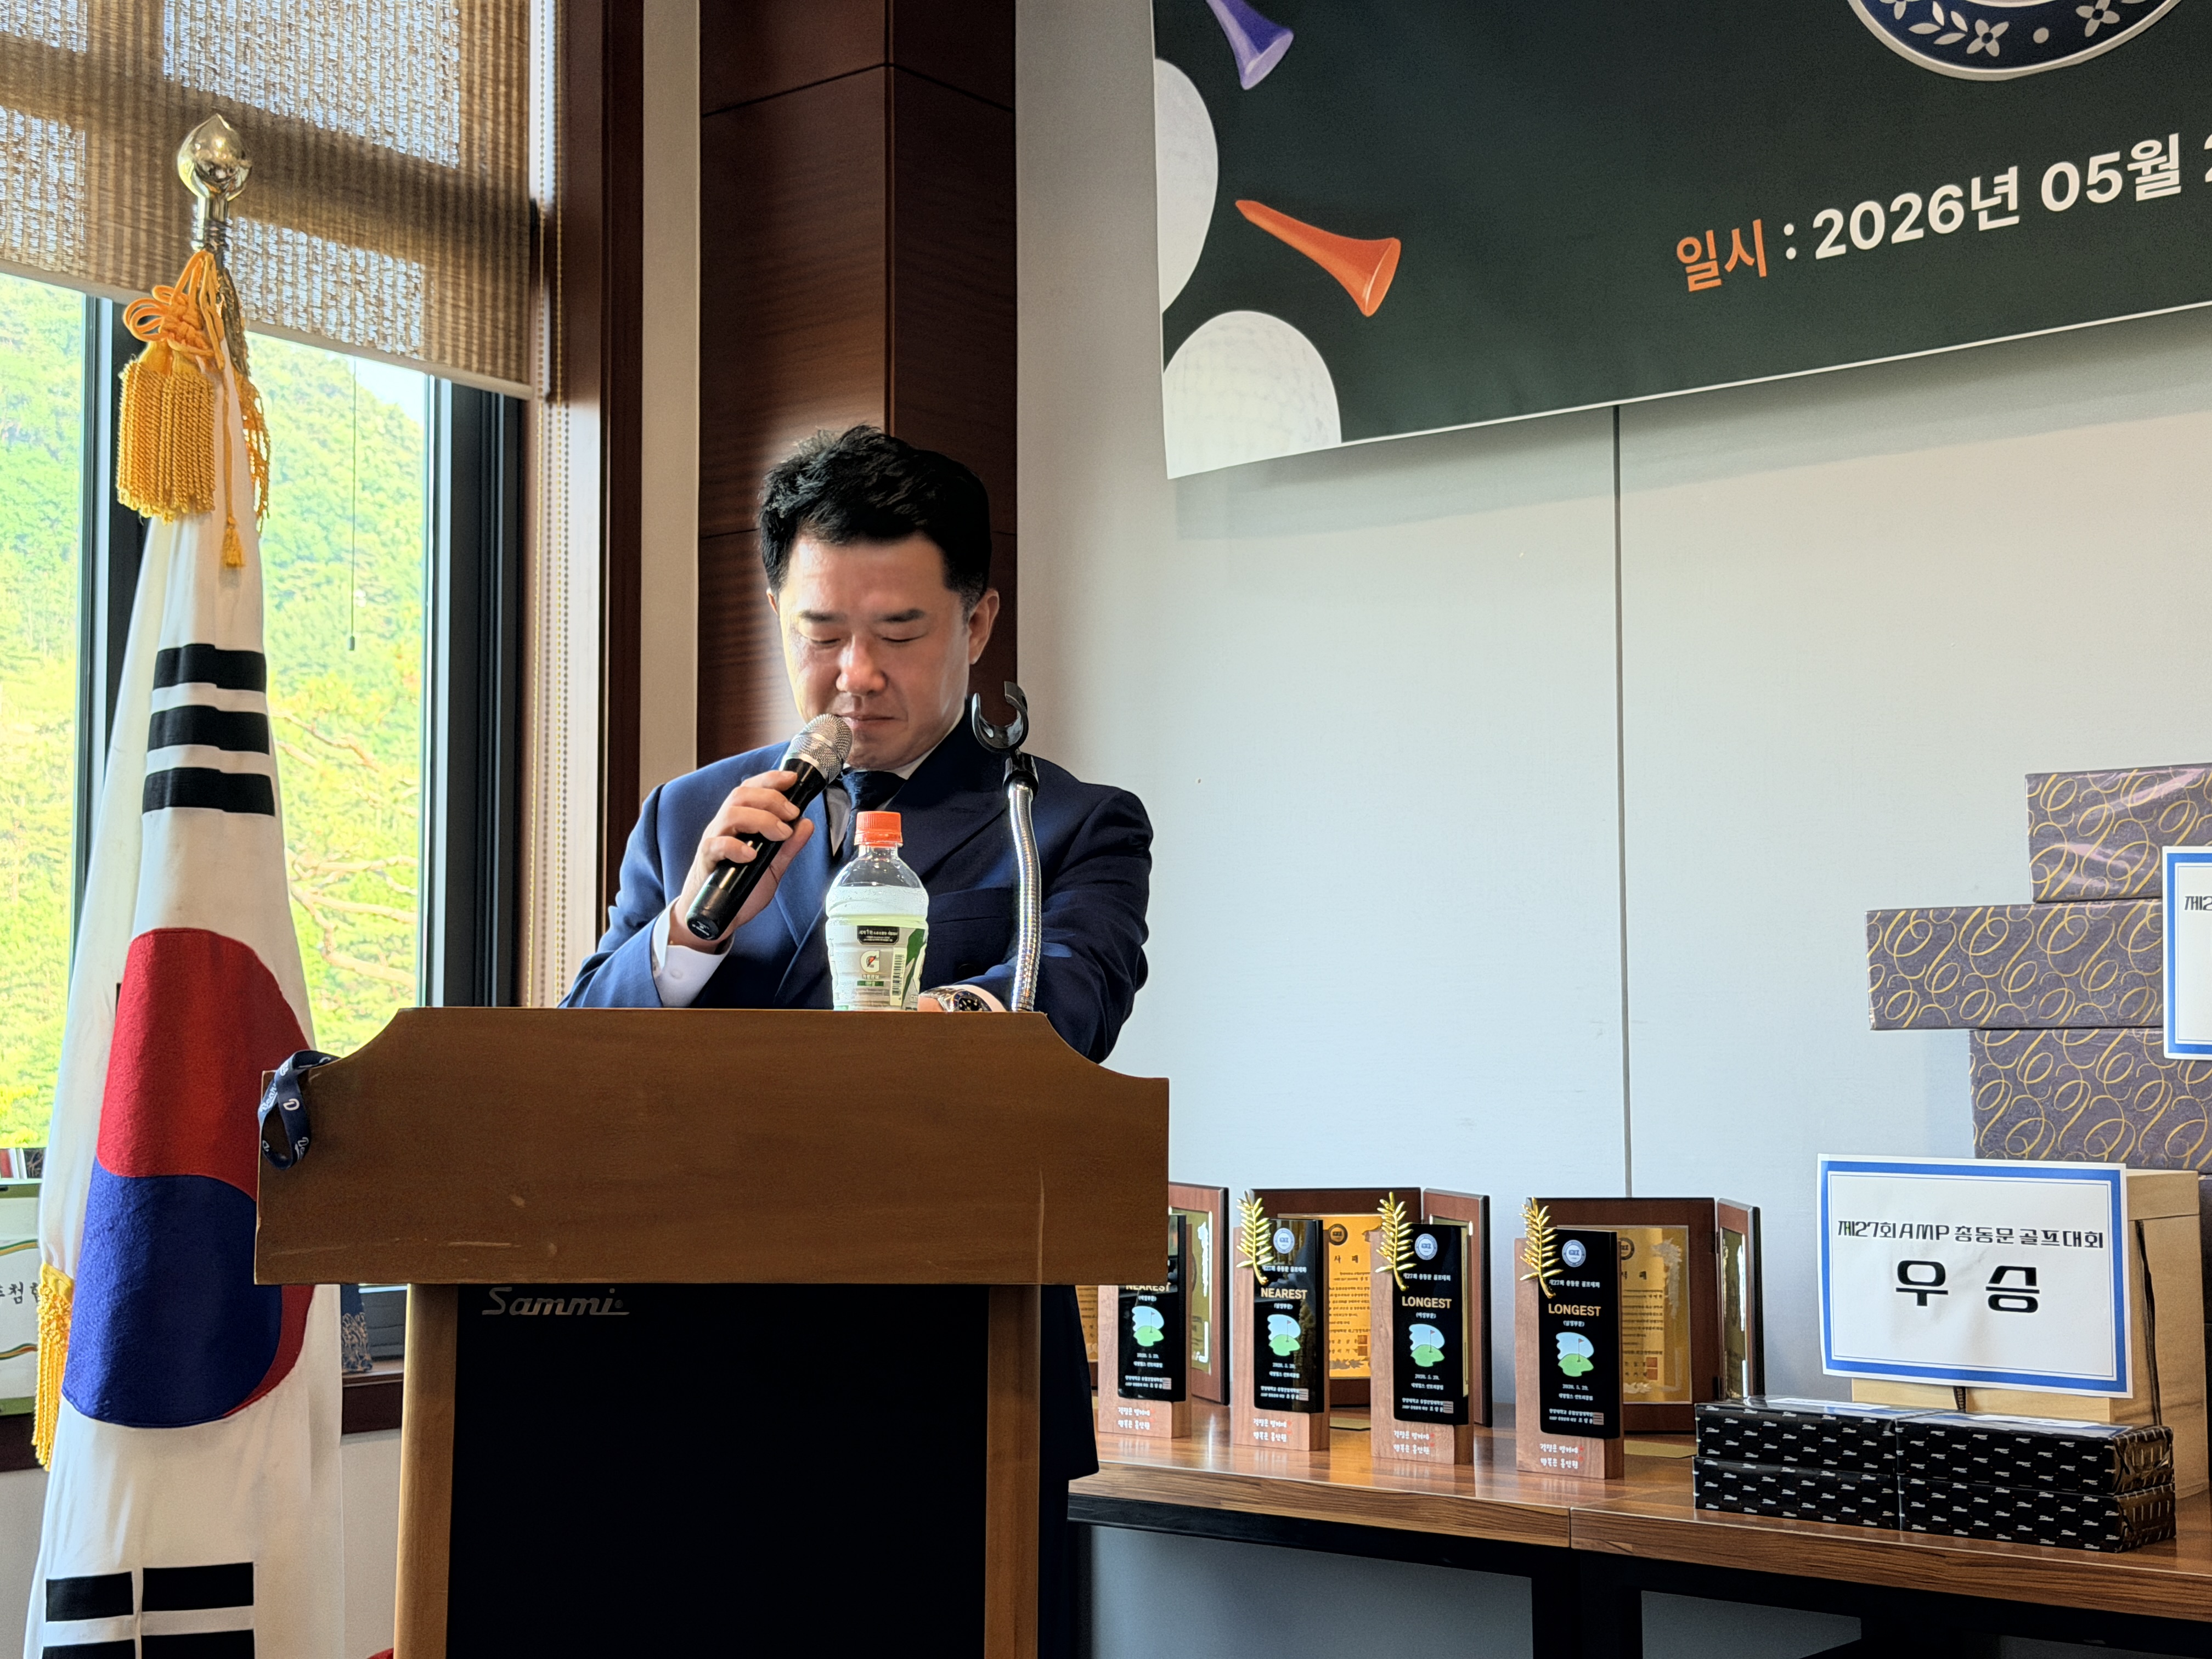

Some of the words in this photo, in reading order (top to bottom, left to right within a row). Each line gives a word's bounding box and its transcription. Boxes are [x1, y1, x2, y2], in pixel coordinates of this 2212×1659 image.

[1677, 219, 1767, 292] 일시
[1813, 166, 2020, 260] 2026년
[2041, 133, 2181, 212] 05월
[1838, 1221, 1897, 1239] 제27회
[1899, 1223, 1950, 1240] AMP
[1954, 1225, 2015, 1244] 총동문
[2019, 1228, 2103, 1248] 골프대회
[482, 1286, 630, 1316] Sammi
[1261, 1287, 1308, 1300] NEAREST
[1402, 1296, 1452, 1309] LONGEST
[1548, 1303, 1601, 1317] LONGEST
